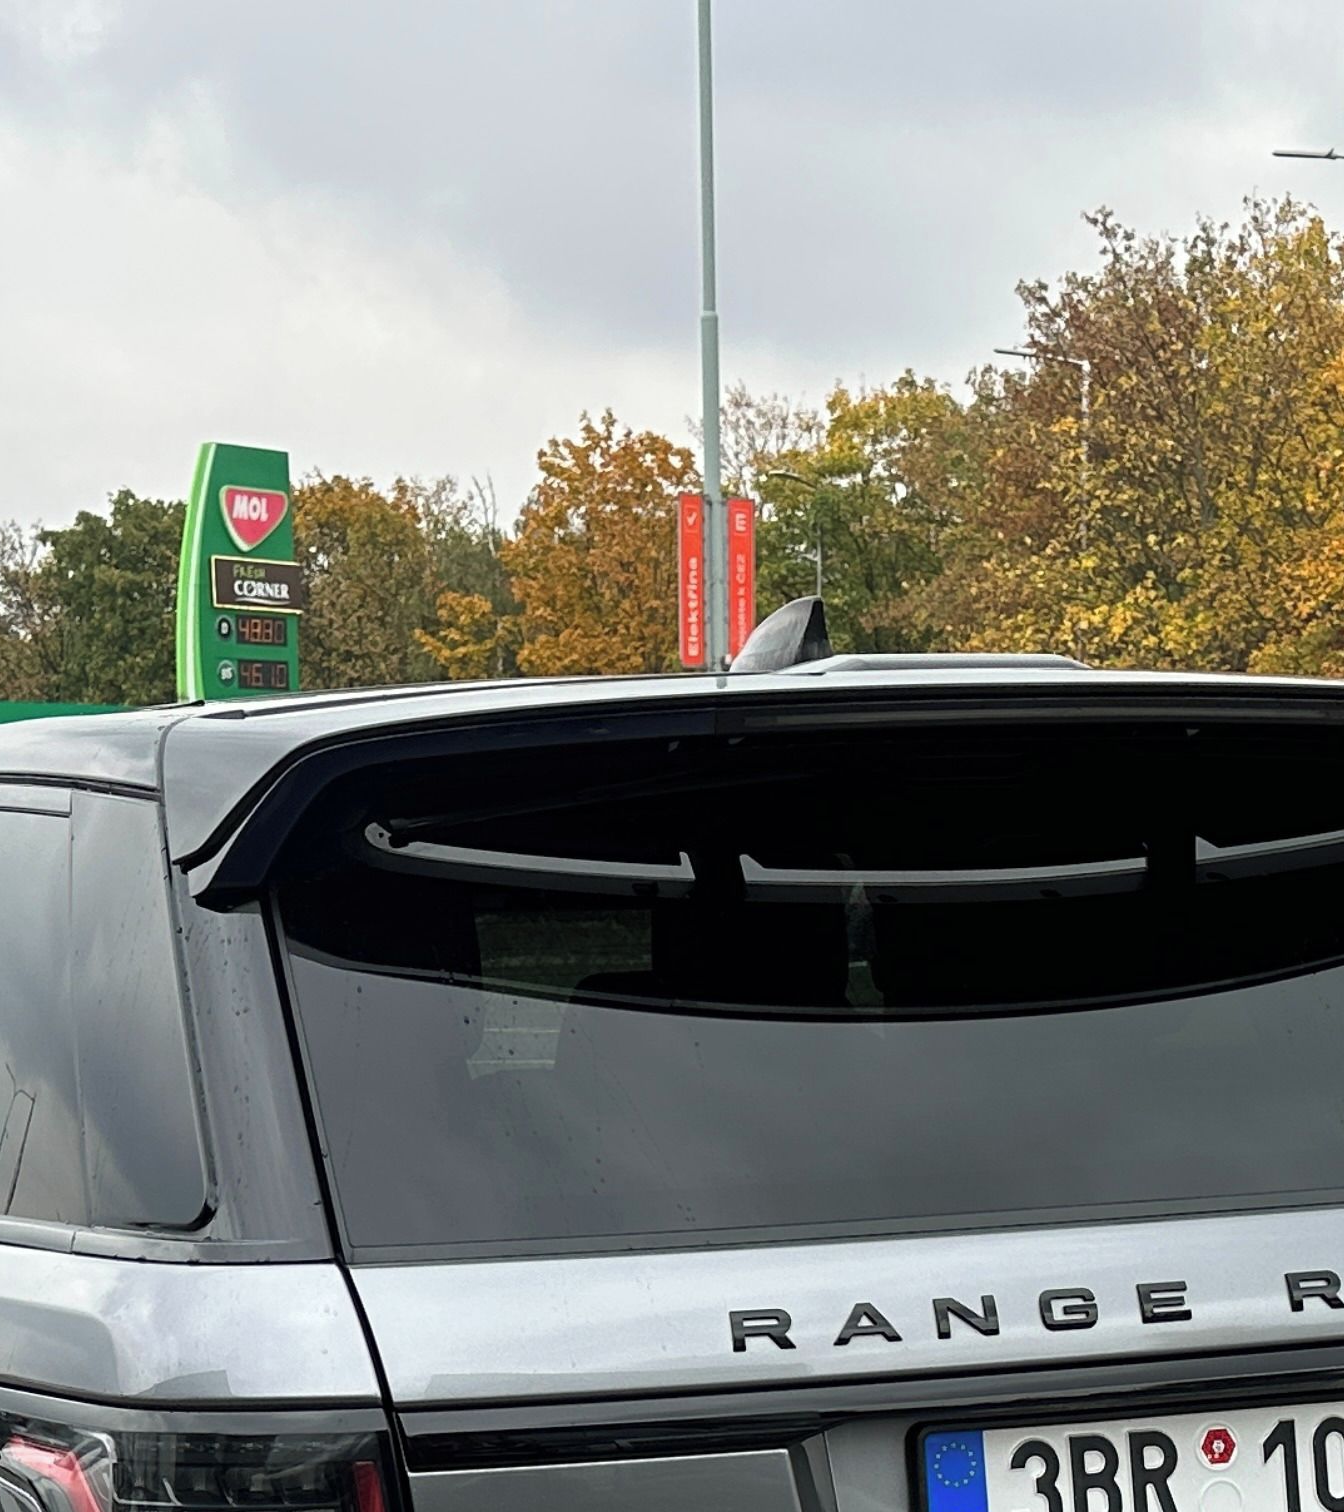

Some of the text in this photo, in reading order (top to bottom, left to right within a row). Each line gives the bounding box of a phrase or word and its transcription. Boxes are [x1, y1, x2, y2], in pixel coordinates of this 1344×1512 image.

[232, 494, 268, 522] MOL
[234, 580, 290, 599] CORNER
[687, 557, 699, 656] Elektřina
[729, 1279, 1193, 1353] RANGE
